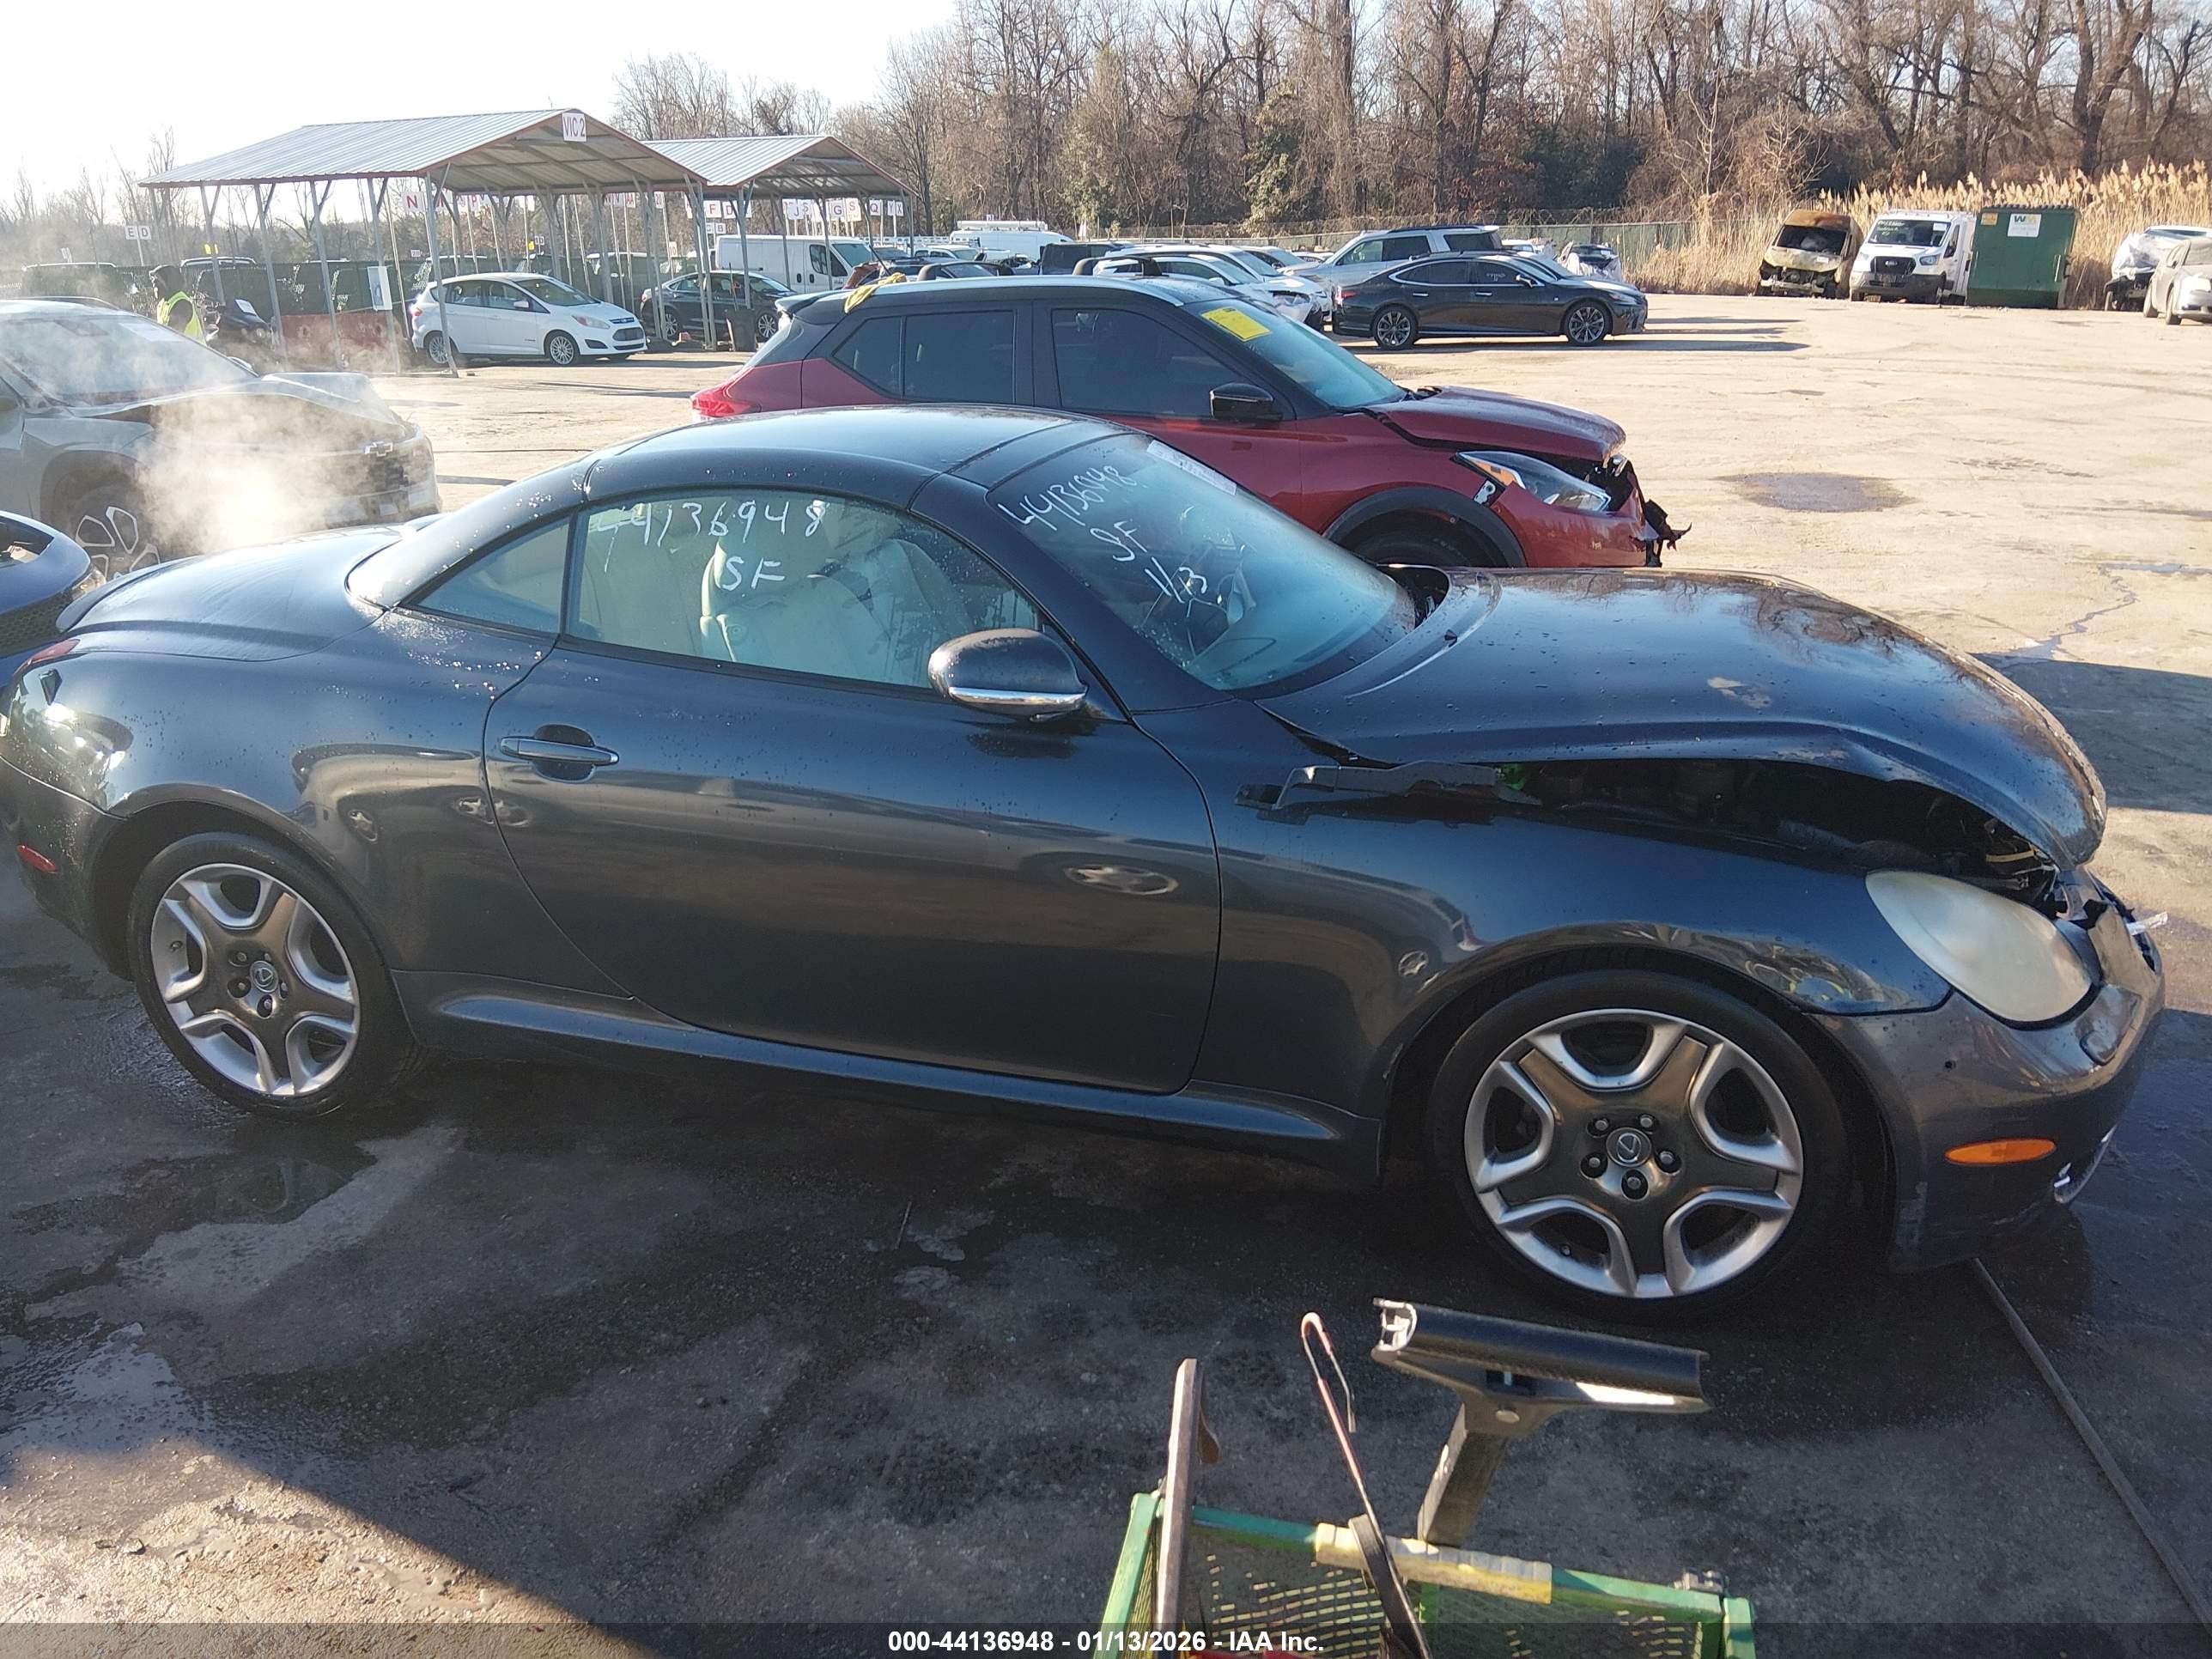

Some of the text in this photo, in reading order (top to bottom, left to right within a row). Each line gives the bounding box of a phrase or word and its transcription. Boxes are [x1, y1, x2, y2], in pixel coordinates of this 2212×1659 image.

[563, 116, 586, 138] VIC 2
[406, 196, 418, 209] N
[709, 204, 716, 215] F
[794, 206, 799, 216] J
[834, 205, 842, 216] G
[870, 203, 878, 213] Q
[897, 203, 902, 213] X
[128, 228, 135, 237] E
[142, 228, 149, 237] D
[718, 224, 724, 233] B
[597, 500, 831, 574] 44136948
[722, 556, 786, 592] SF
